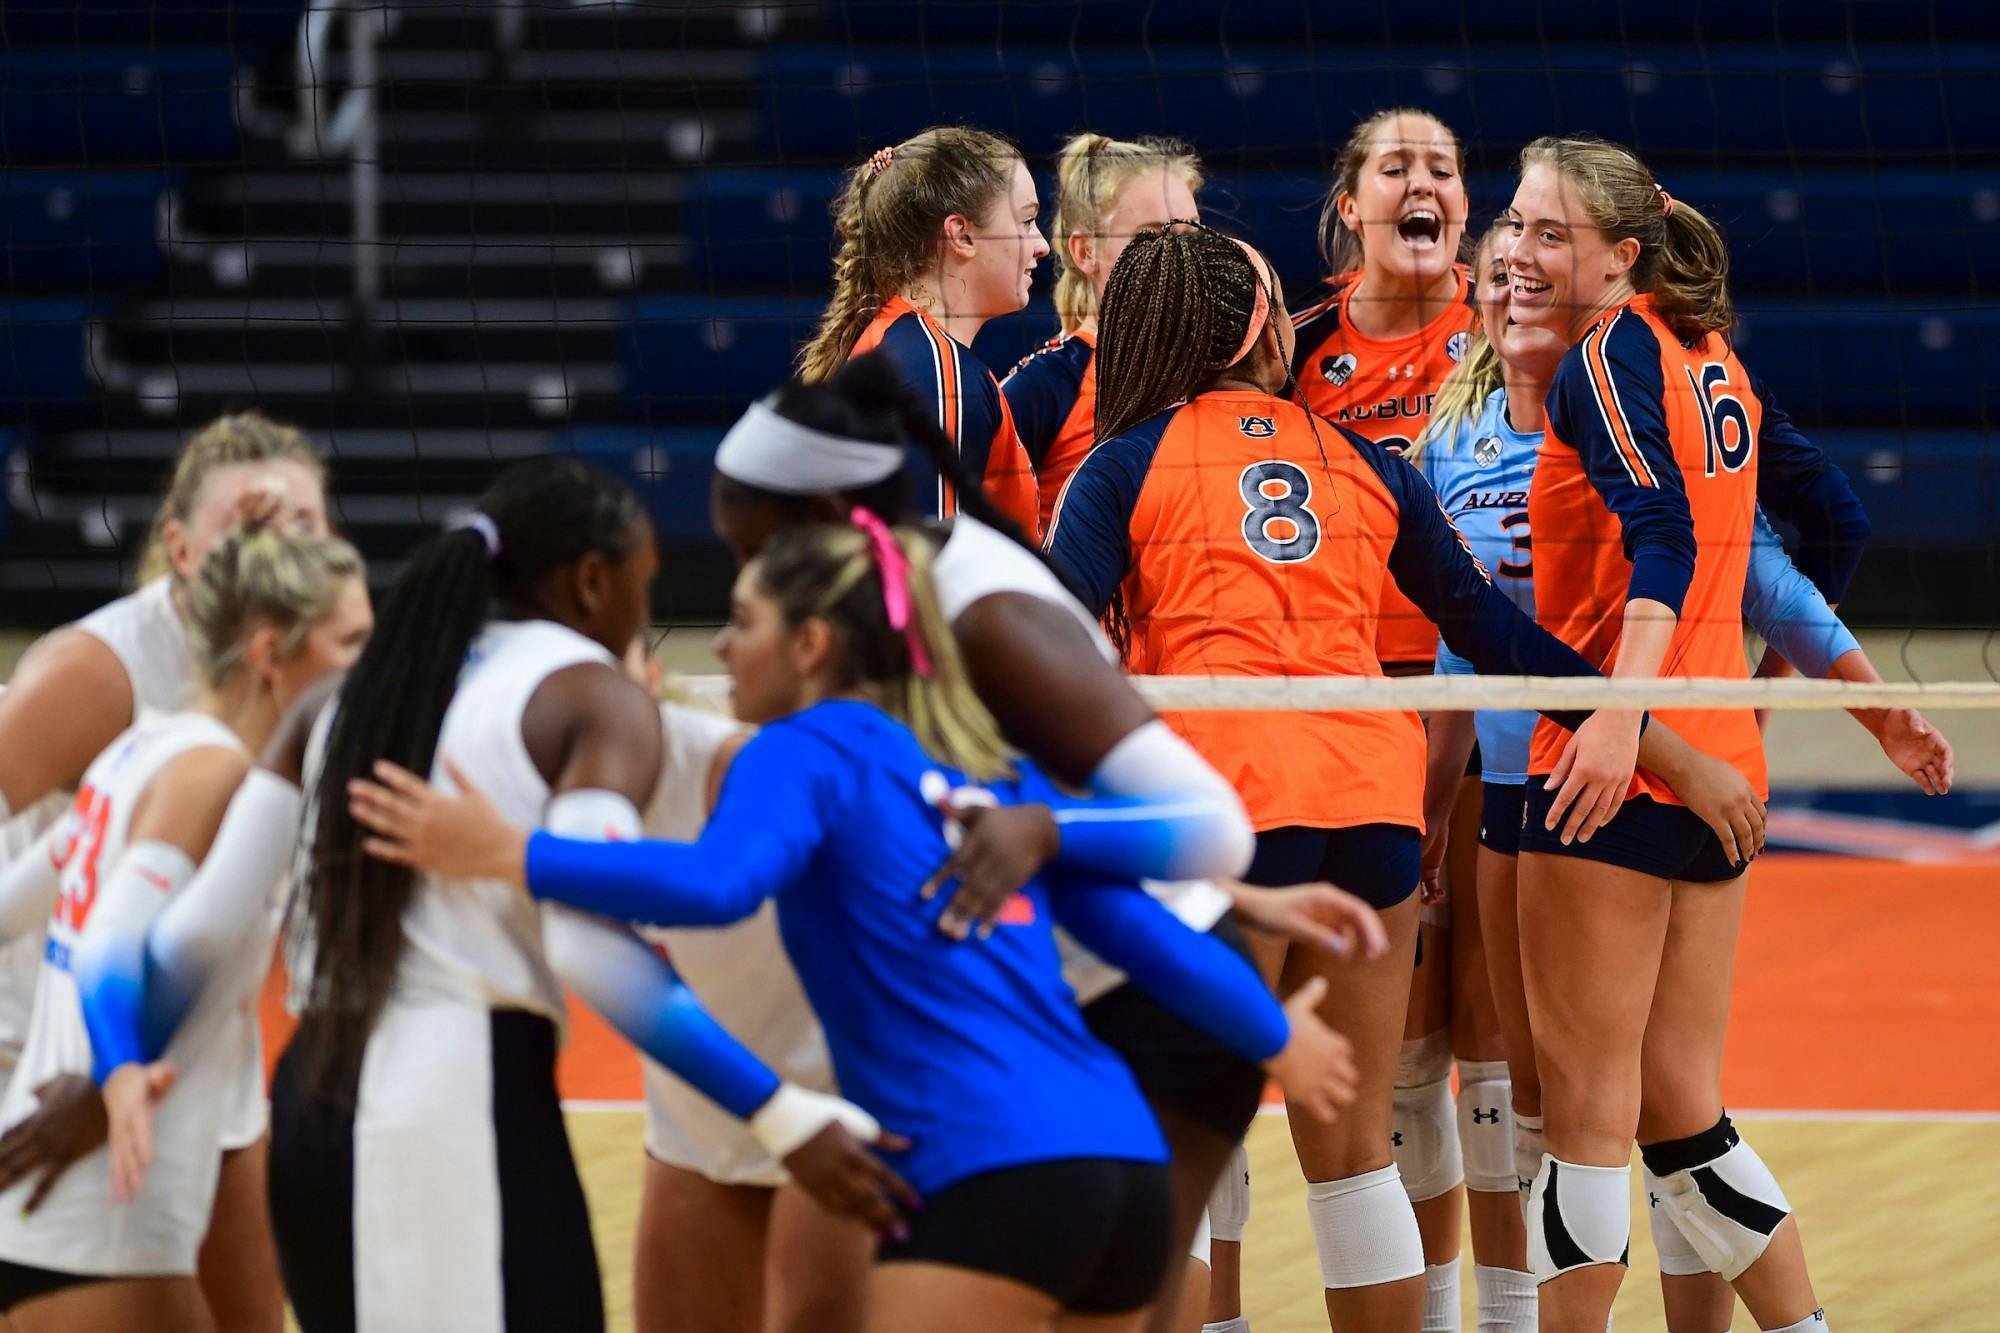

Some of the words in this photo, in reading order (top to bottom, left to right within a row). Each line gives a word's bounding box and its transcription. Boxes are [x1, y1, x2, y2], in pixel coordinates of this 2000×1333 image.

[1683, 361, 1753, 478] 16
[1238, 459, 1322, 564] 8
[1461, 491, 1530, 511] AUB
